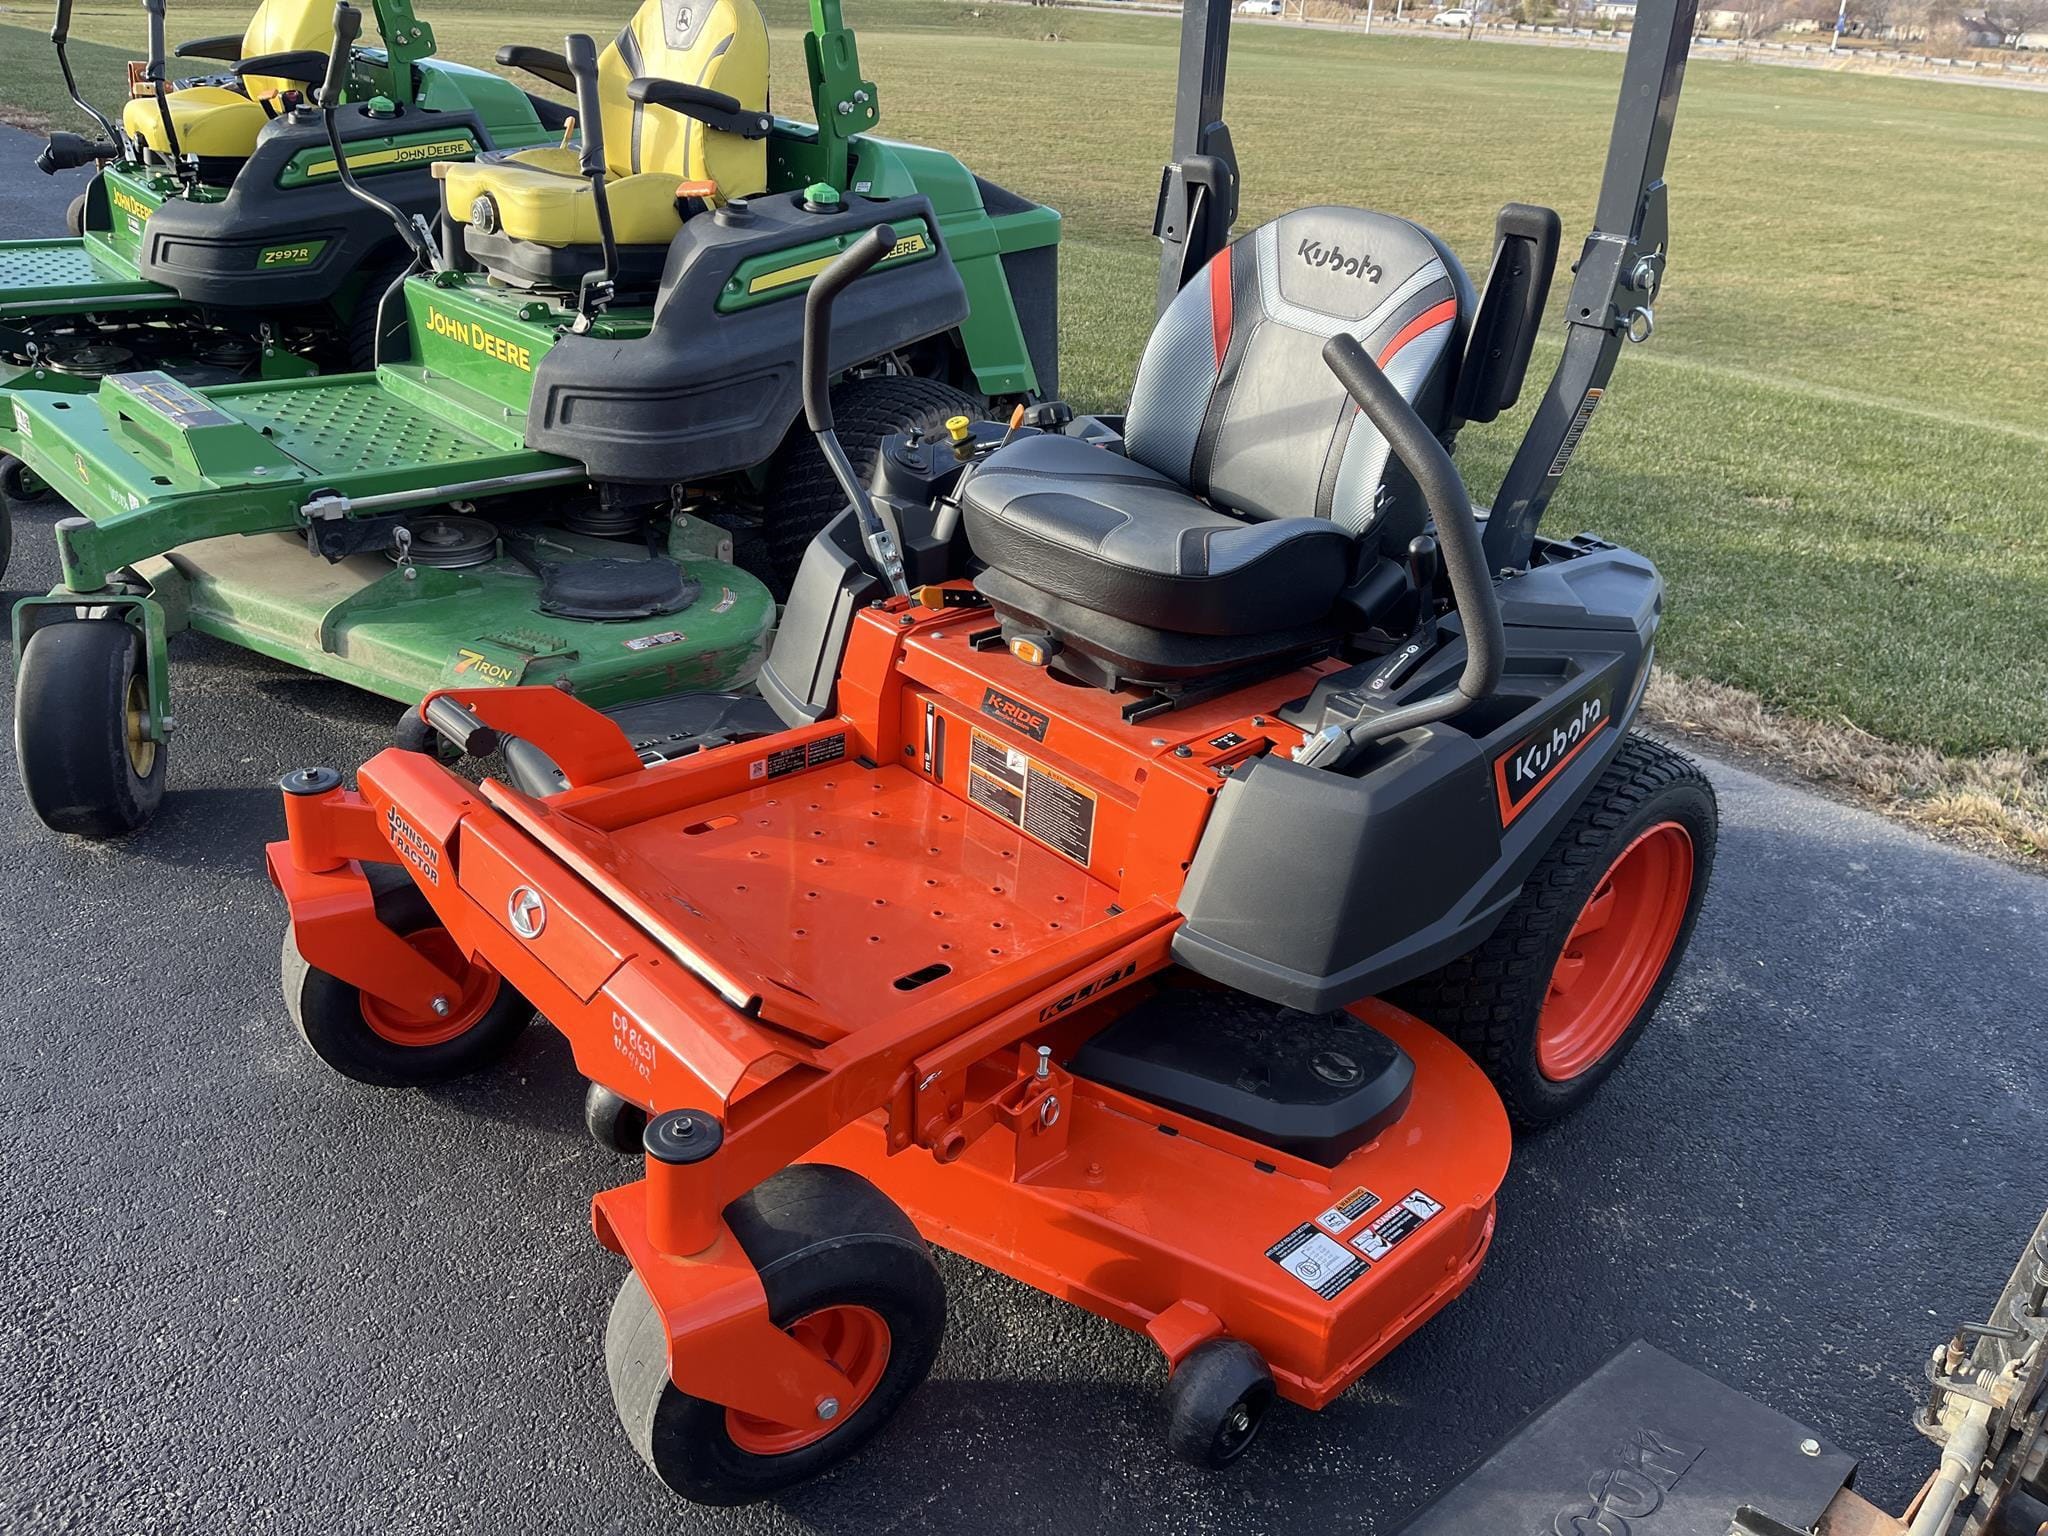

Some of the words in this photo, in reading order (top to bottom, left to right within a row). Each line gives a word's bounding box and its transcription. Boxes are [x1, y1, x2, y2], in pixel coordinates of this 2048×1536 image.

[394, 149, 425, 161] JOHN
[427, 143, 465, 156] DEERE
[1297, 238, 1383, 285] Kubota
[426, 304, 470, 346] JOHN
[471, 321, 532, 374] DEERE
[989, 693, 1043, 730] K-RIDE
[1516, 698, 1601, 782] Kubota
[387, 805, 439, 866] JOHNSON
[389, 821, 439, 886] TRACTOR
